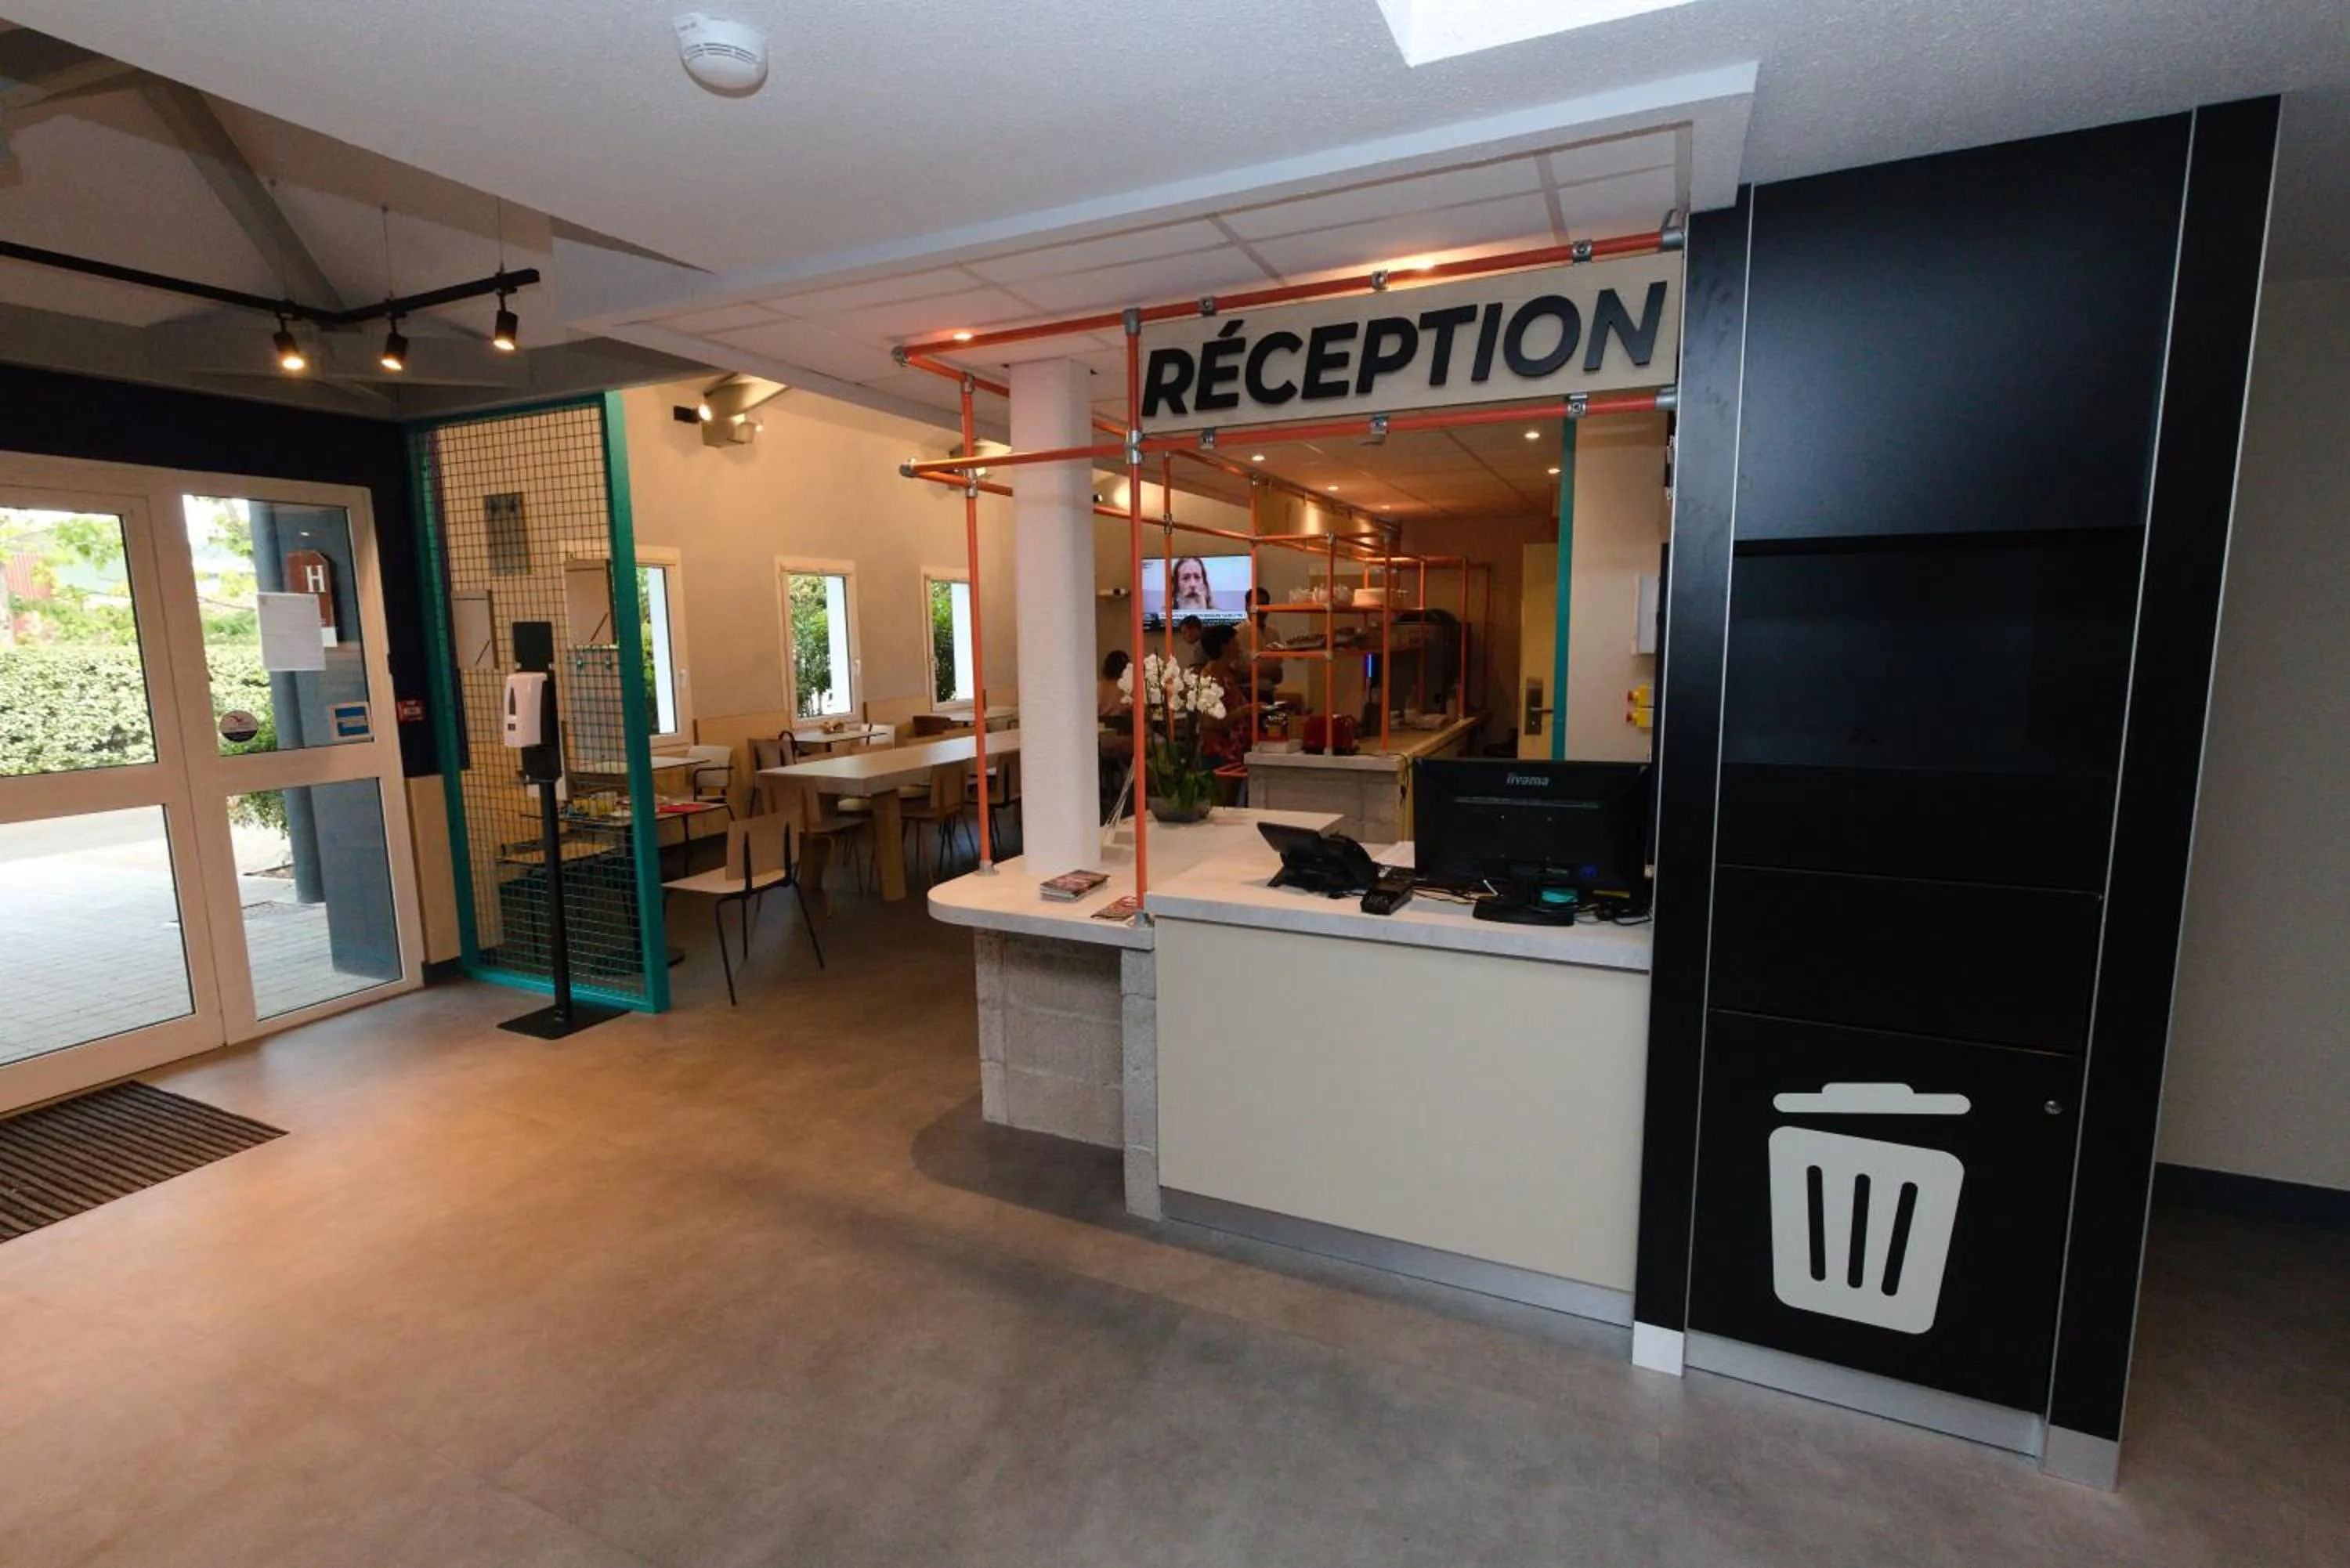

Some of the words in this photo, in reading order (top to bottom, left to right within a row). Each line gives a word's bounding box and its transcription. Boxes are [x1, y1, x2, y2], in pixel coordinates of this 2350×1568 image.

[1141, 281, 1668, 417] RÉCEPTION
[306, 565, 326, 593] H
[1506, 772, 1549, 786] iiyama
